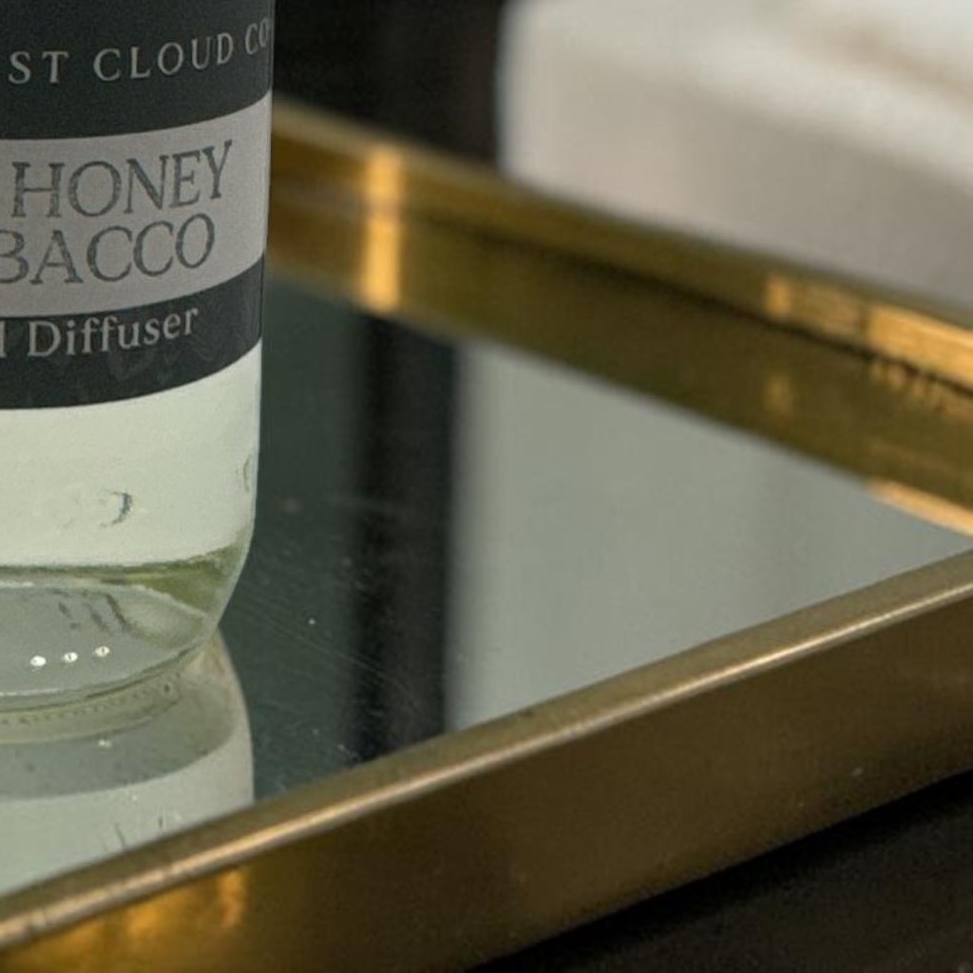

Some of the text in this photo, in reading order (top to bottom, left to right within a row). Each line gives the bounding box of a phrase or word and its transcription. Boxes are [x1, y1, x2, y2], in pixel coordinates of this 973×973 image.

[9, 50, 70, 84] ST
[94, 32, 234, 81] CLOUD
[11, 140, 233, 218] HONEY
[28, 306, 199, 359] Diffuser
